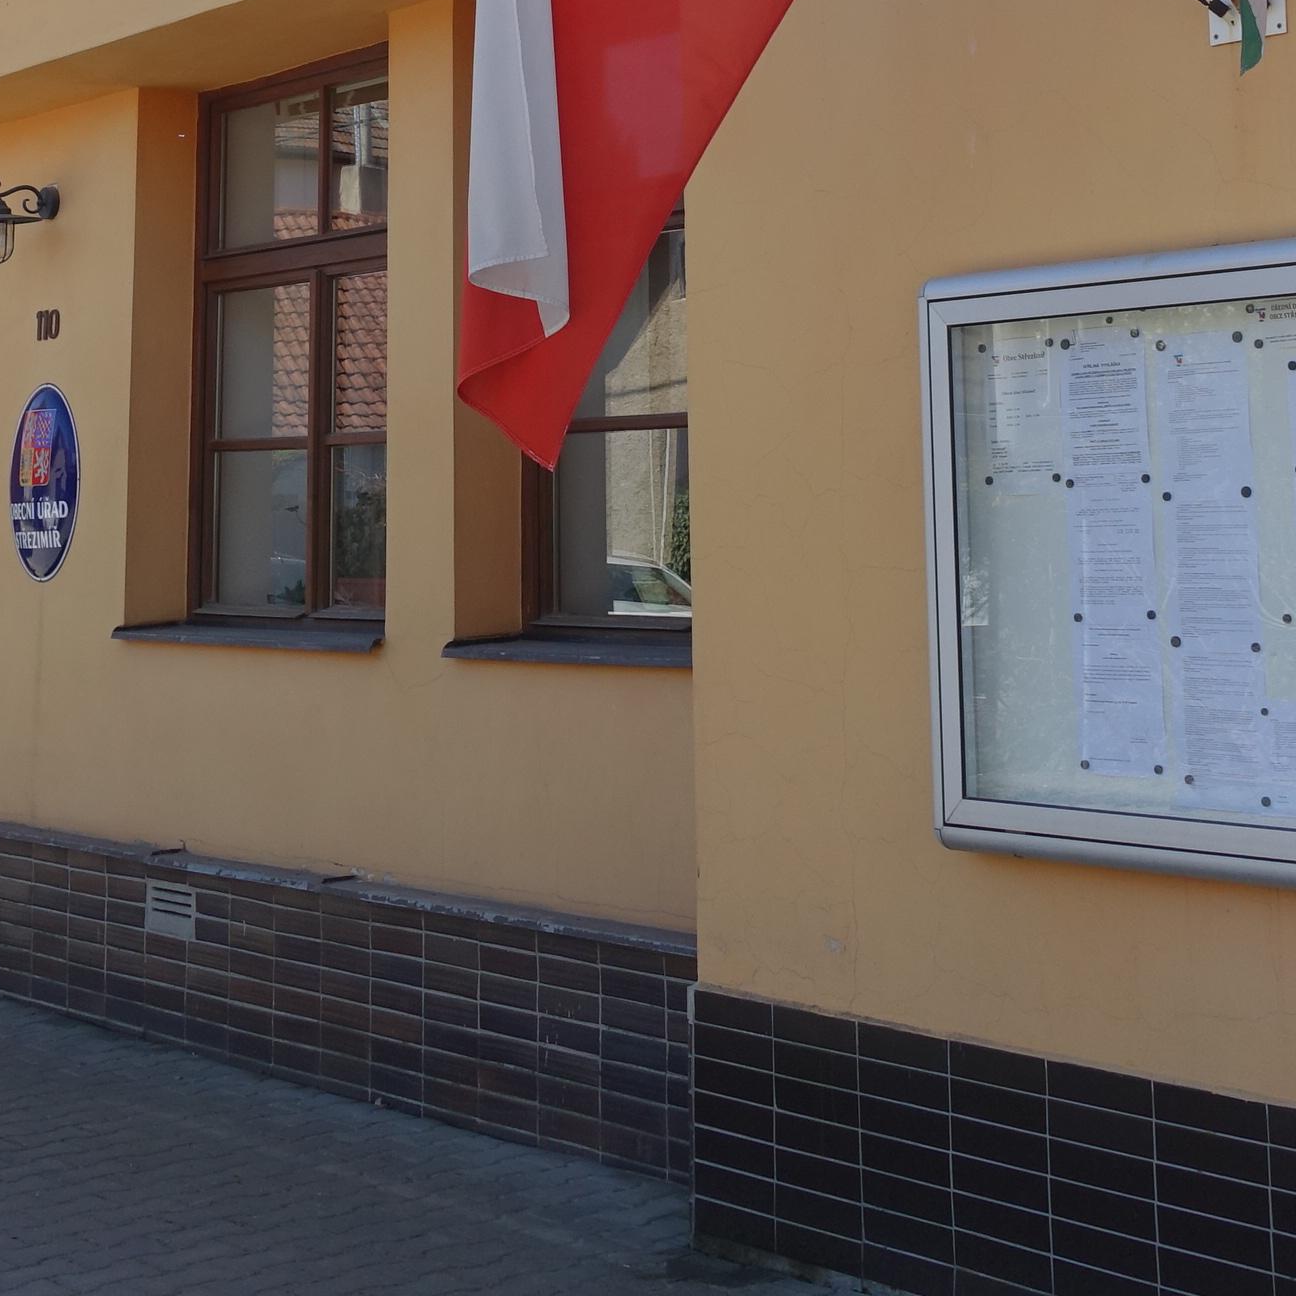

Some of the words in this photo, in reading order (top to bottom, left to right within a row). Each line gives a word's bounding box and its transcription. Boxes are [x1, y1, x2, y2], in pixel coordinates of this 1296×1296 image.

[36, 309, 60, 341] 110
[11, 497, 35, 520] OBECNÍ
[37, 496, 69, 520] ÚŘAD
[15, 525, 62, 550] STŘEZIMÍŘ
